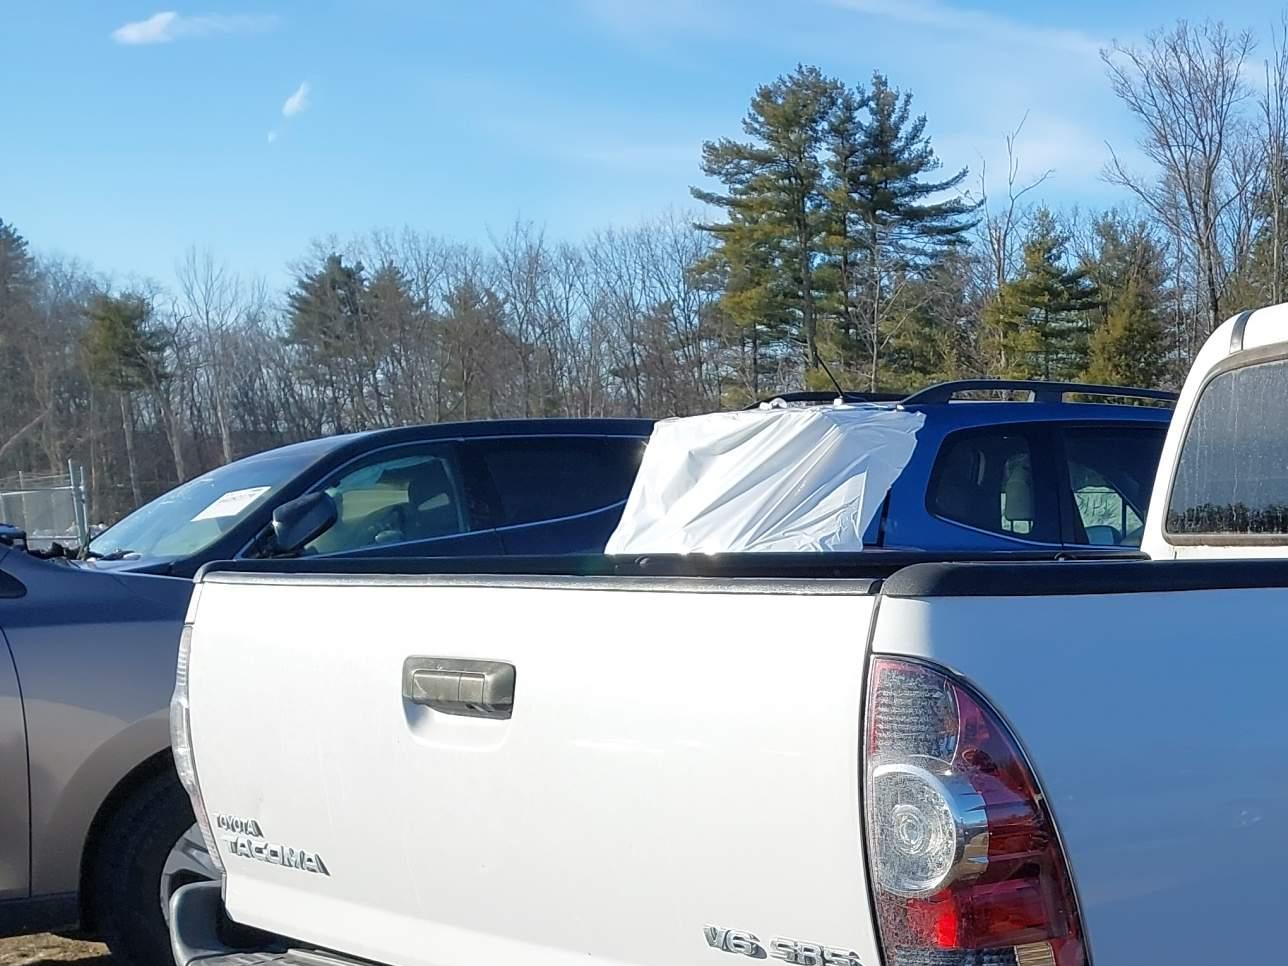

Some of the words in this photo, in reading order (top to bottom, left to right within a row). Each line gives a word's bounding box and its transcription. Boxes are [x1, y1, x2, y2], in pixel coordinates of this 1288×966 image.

[214, 813, 264, 838] TOYOTA
[223, 837, 331, 877] TACOMA
[702, 925, 768, 960] V6
